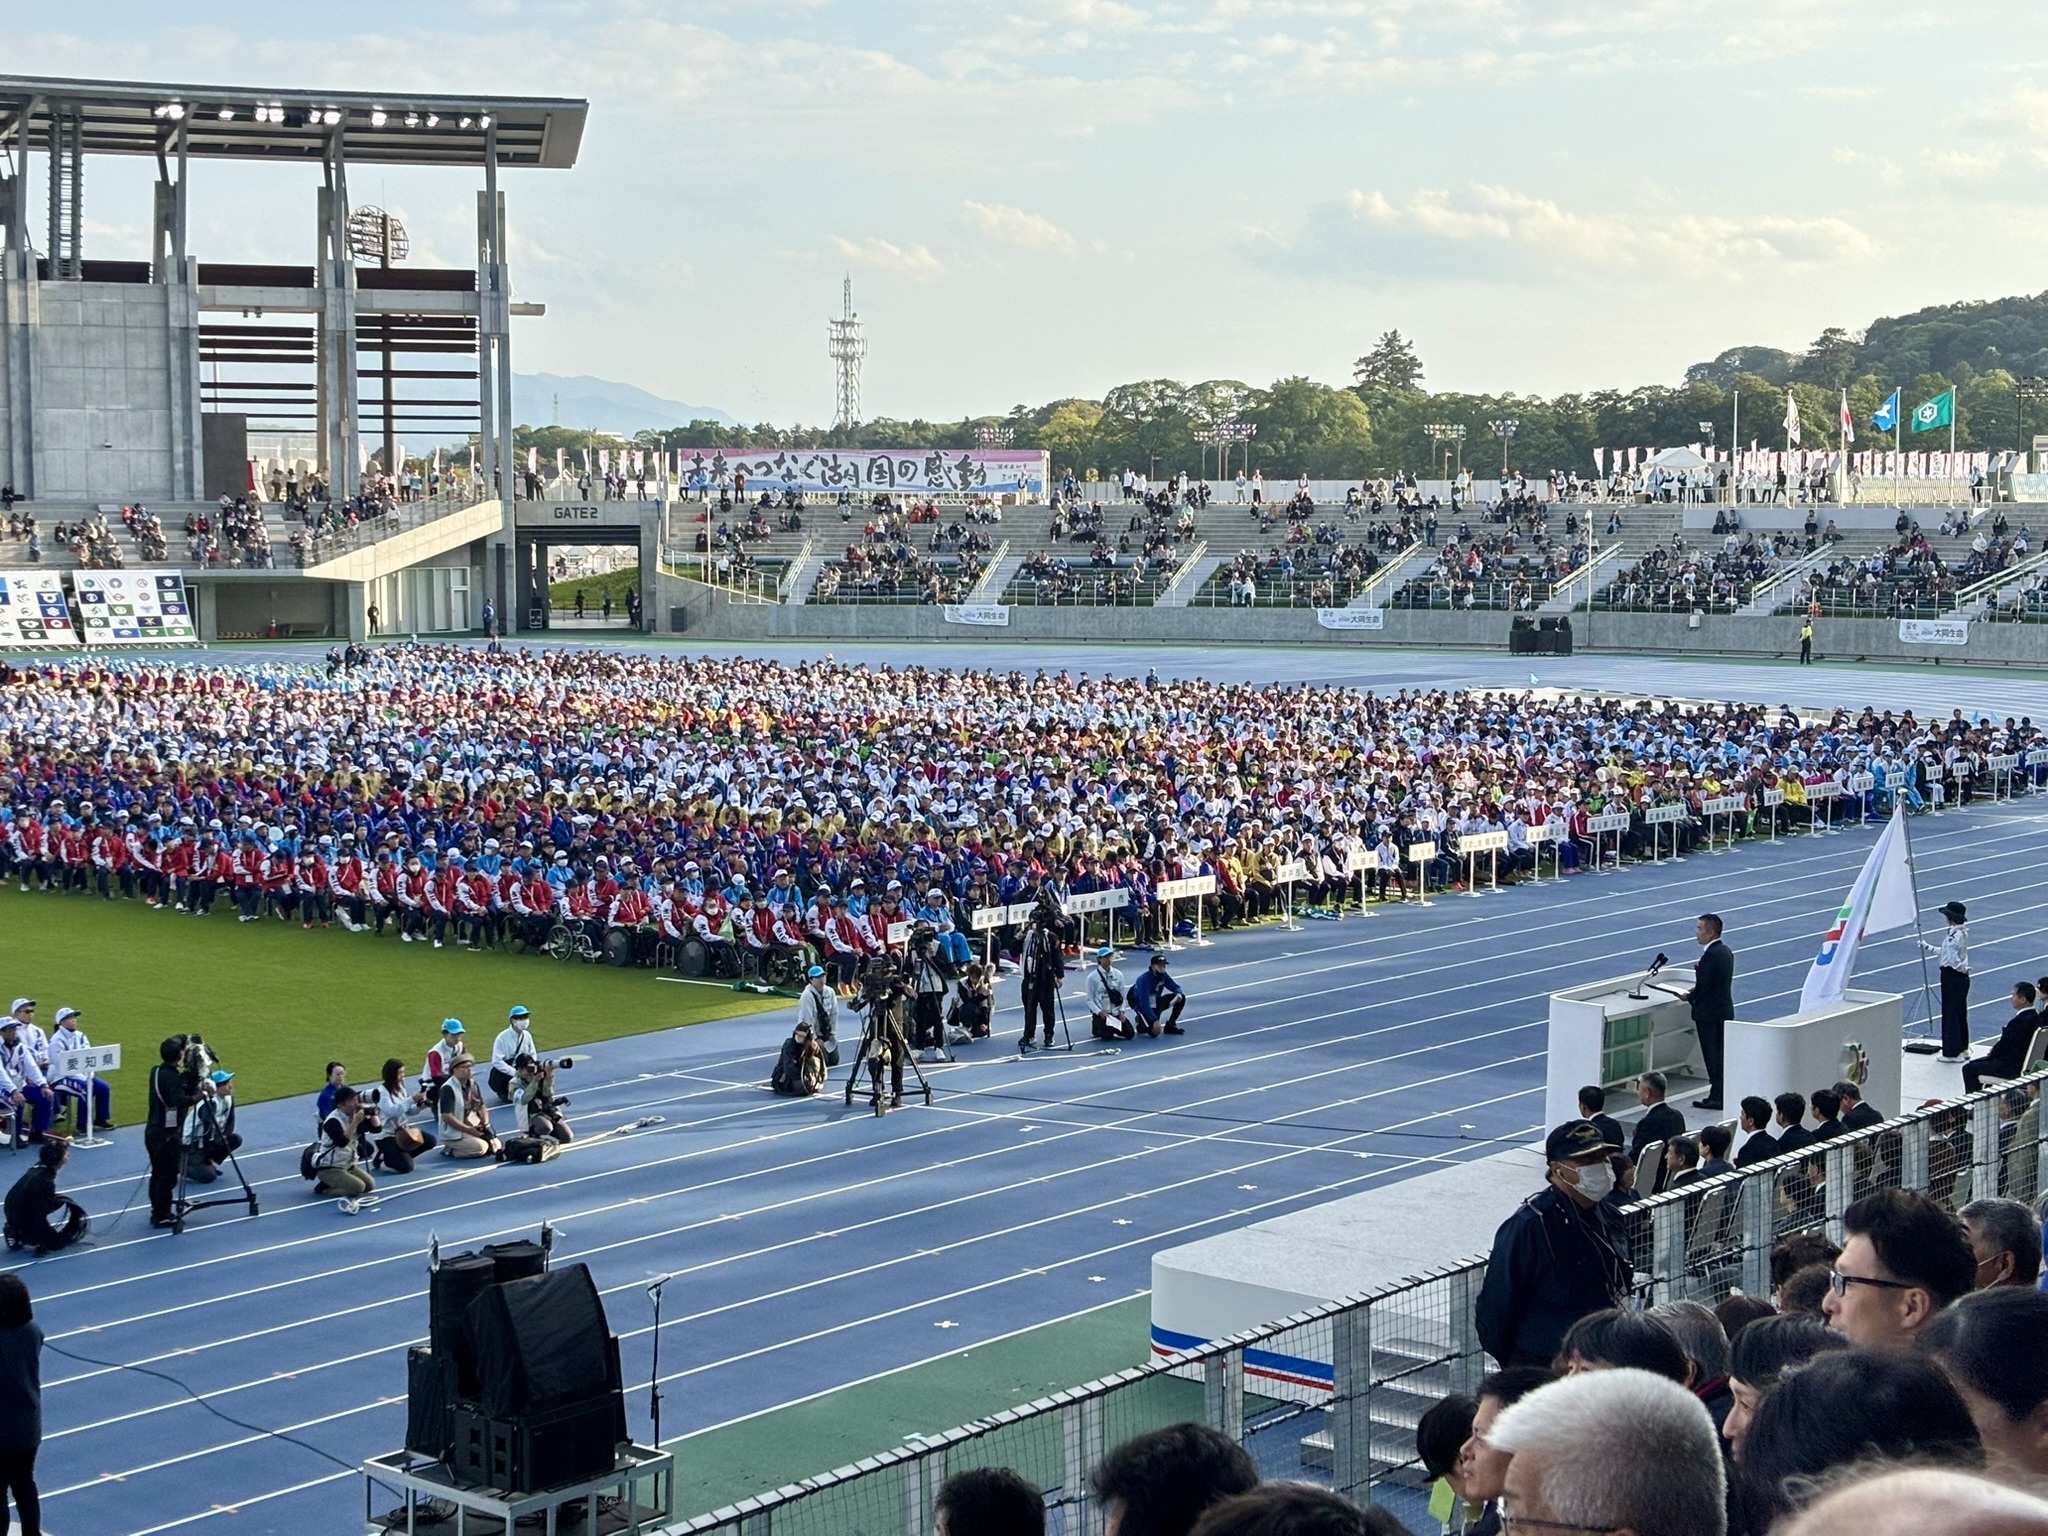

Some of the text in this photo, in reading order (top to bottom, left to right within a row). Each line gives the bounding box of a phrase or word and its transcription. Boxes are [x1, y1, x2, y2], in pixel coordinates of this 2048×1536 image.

[976, 611, 1006, 620] 大同生命
[1350, 615, 1380, 624] 大同生命
[1934, 628, 1964, 638] 大同生命
[66, 1051, 115, 1071] 愛知県
